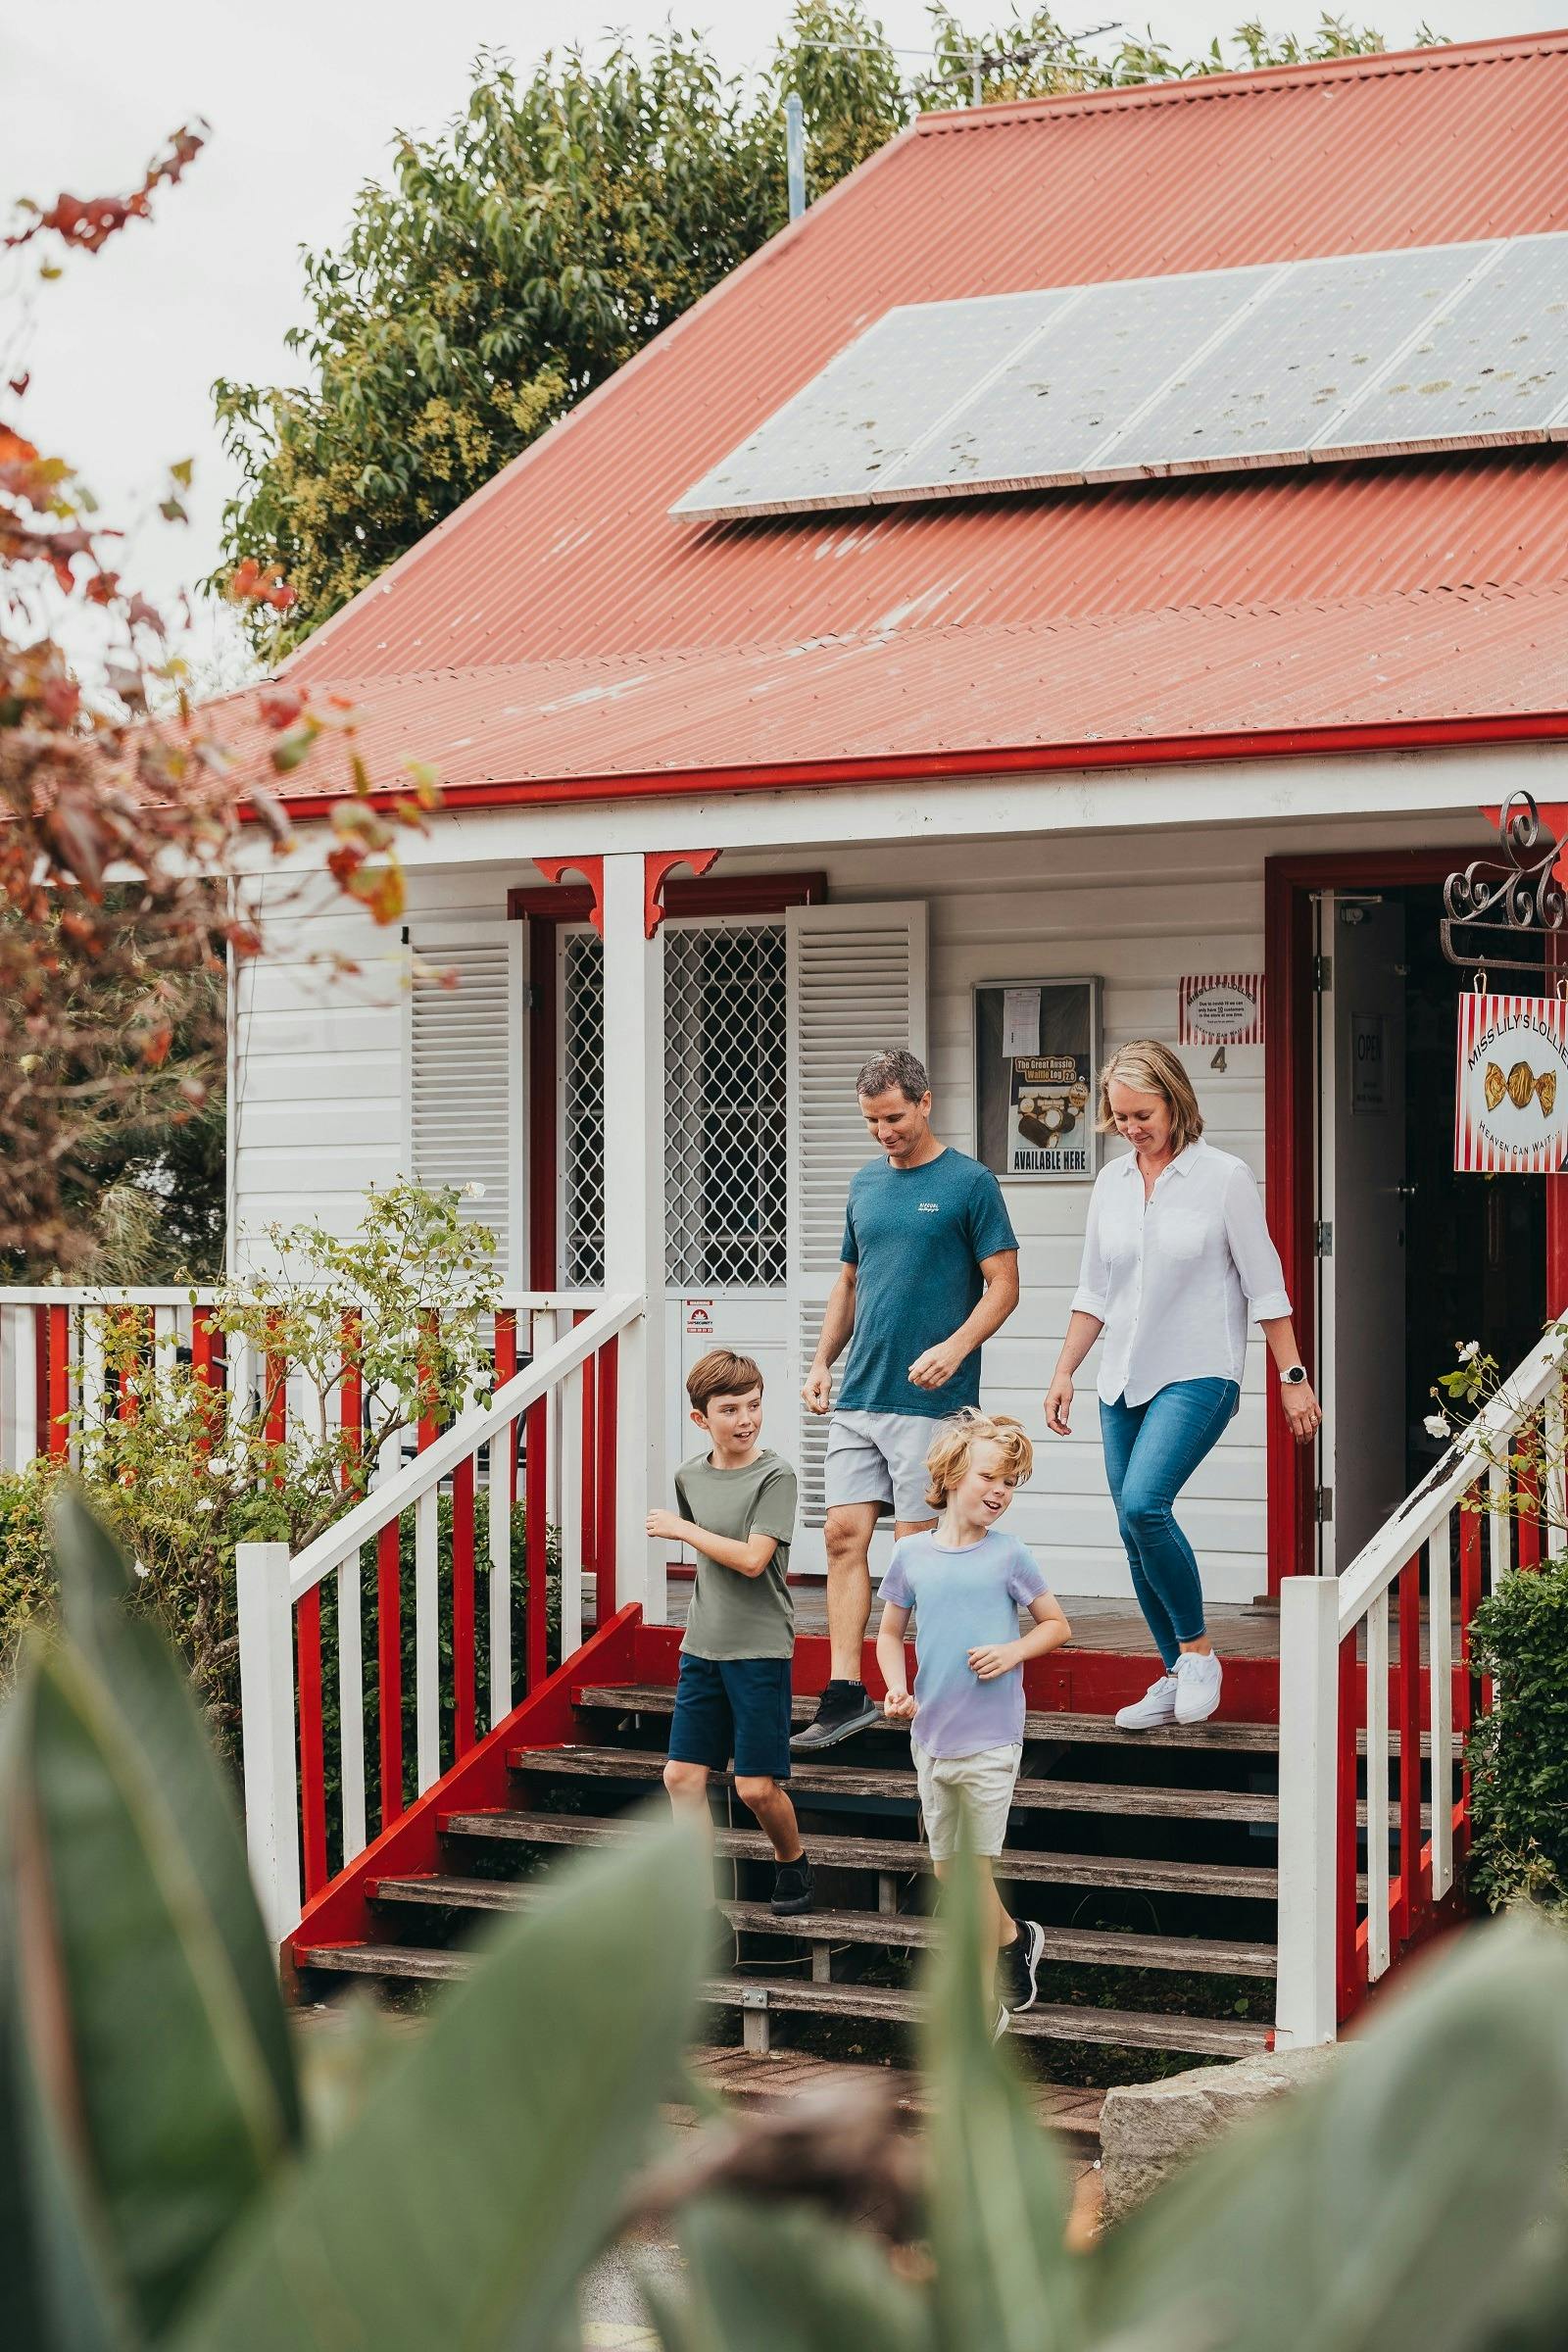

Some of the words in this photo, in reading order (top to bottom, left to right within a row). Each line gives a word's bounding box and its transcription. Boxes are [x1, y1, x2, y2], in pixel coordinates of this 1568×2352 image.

[1187, 989, 1203, 1006] MISS
[1228, 982, 1256, 1004] LOLLIES
[1357, 1034, 1381, 1060] OPEN
[1467, 1028, 1494, 1071] MISS
[1496, 1014, 1530, 1036] LILY'S
[1533, 1017, 1568, 1069] LOLLIE
[1018, 1060, 1029, 1069] The
[1031, 1059, 1049, 1069] Great
[1051, 1059, 1073, 1068] Aussie
[1211, 1047, 1227, 1072] 4
[1027, 1070, 1049, 1079] Waffle
[1051, 1069, 1062, 1079] Log
[1065, 1072, 1075, 1081] 2.0
[1014, 1151, 1060, 1169] AVAILABLE
[1064, 1151, 1085, 1169] HERE
